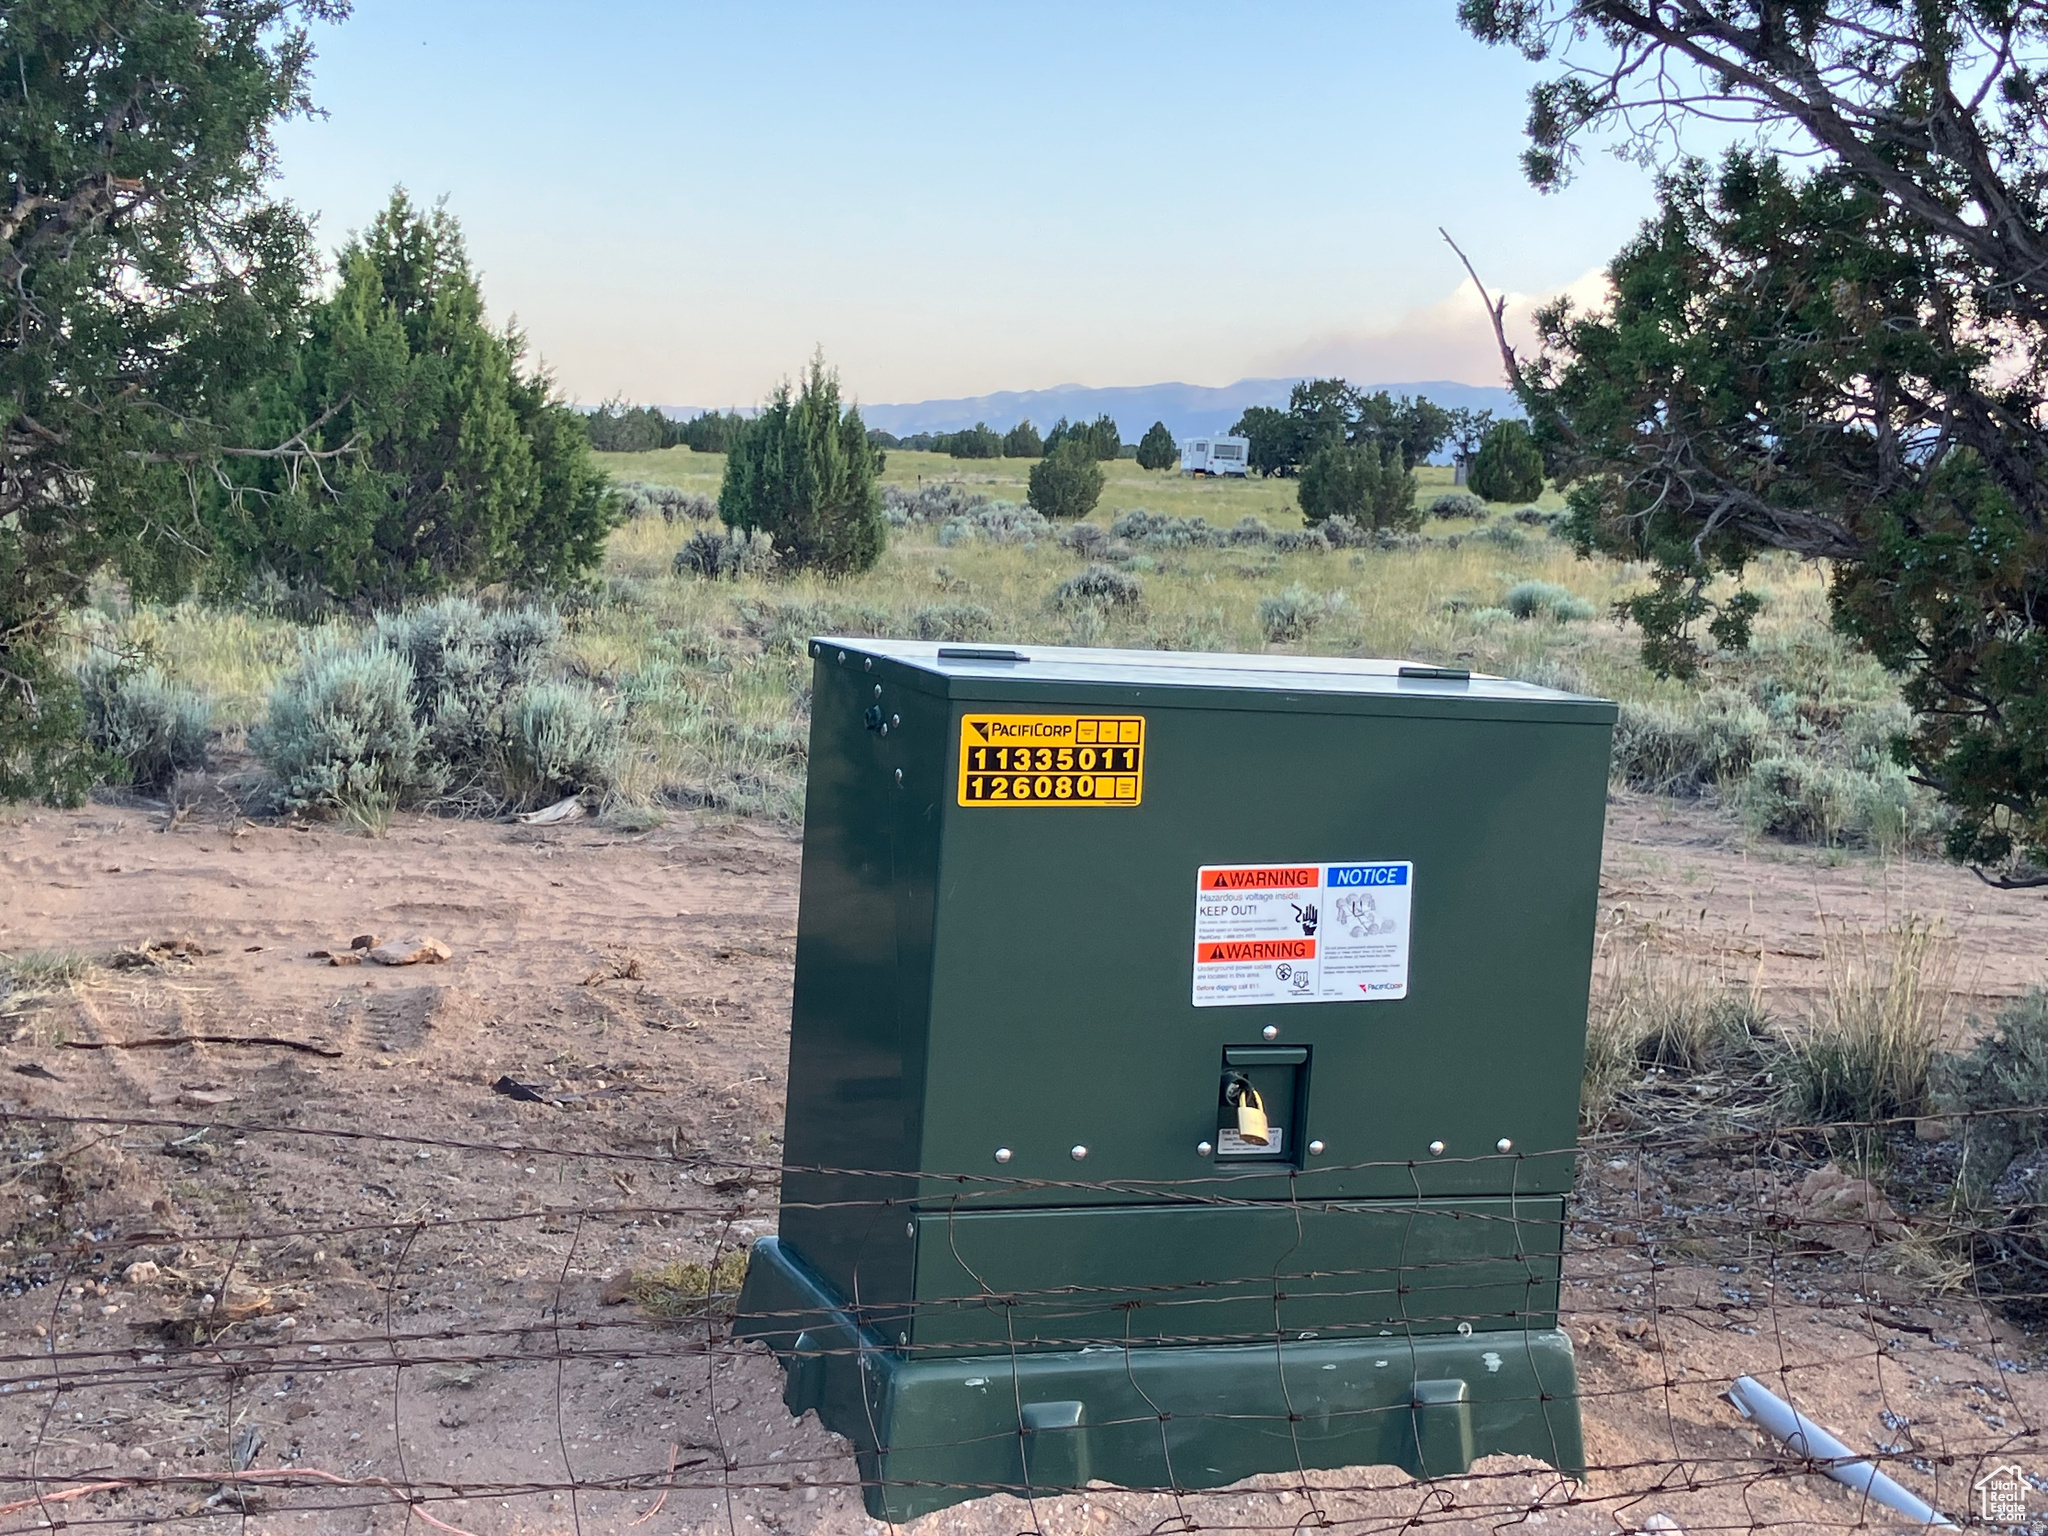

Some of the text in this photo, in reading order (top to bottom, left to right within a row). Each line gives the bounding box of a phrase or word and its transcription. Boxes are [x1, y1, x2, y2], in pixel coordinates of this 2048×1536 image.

[974, 748, 1134, 771] 11335011
[971, 775, 1095, 799] 126080
[1229, 870, 1309, 887] WARNING
[1337, 867, 1398, 885] NOTICE
[1200, 891, 1301, 902] Hazardous voltage inside.
[1199, 905, 1257, 916] KEEP OUT!
[1226, 942, 1306, 959] WARNING
